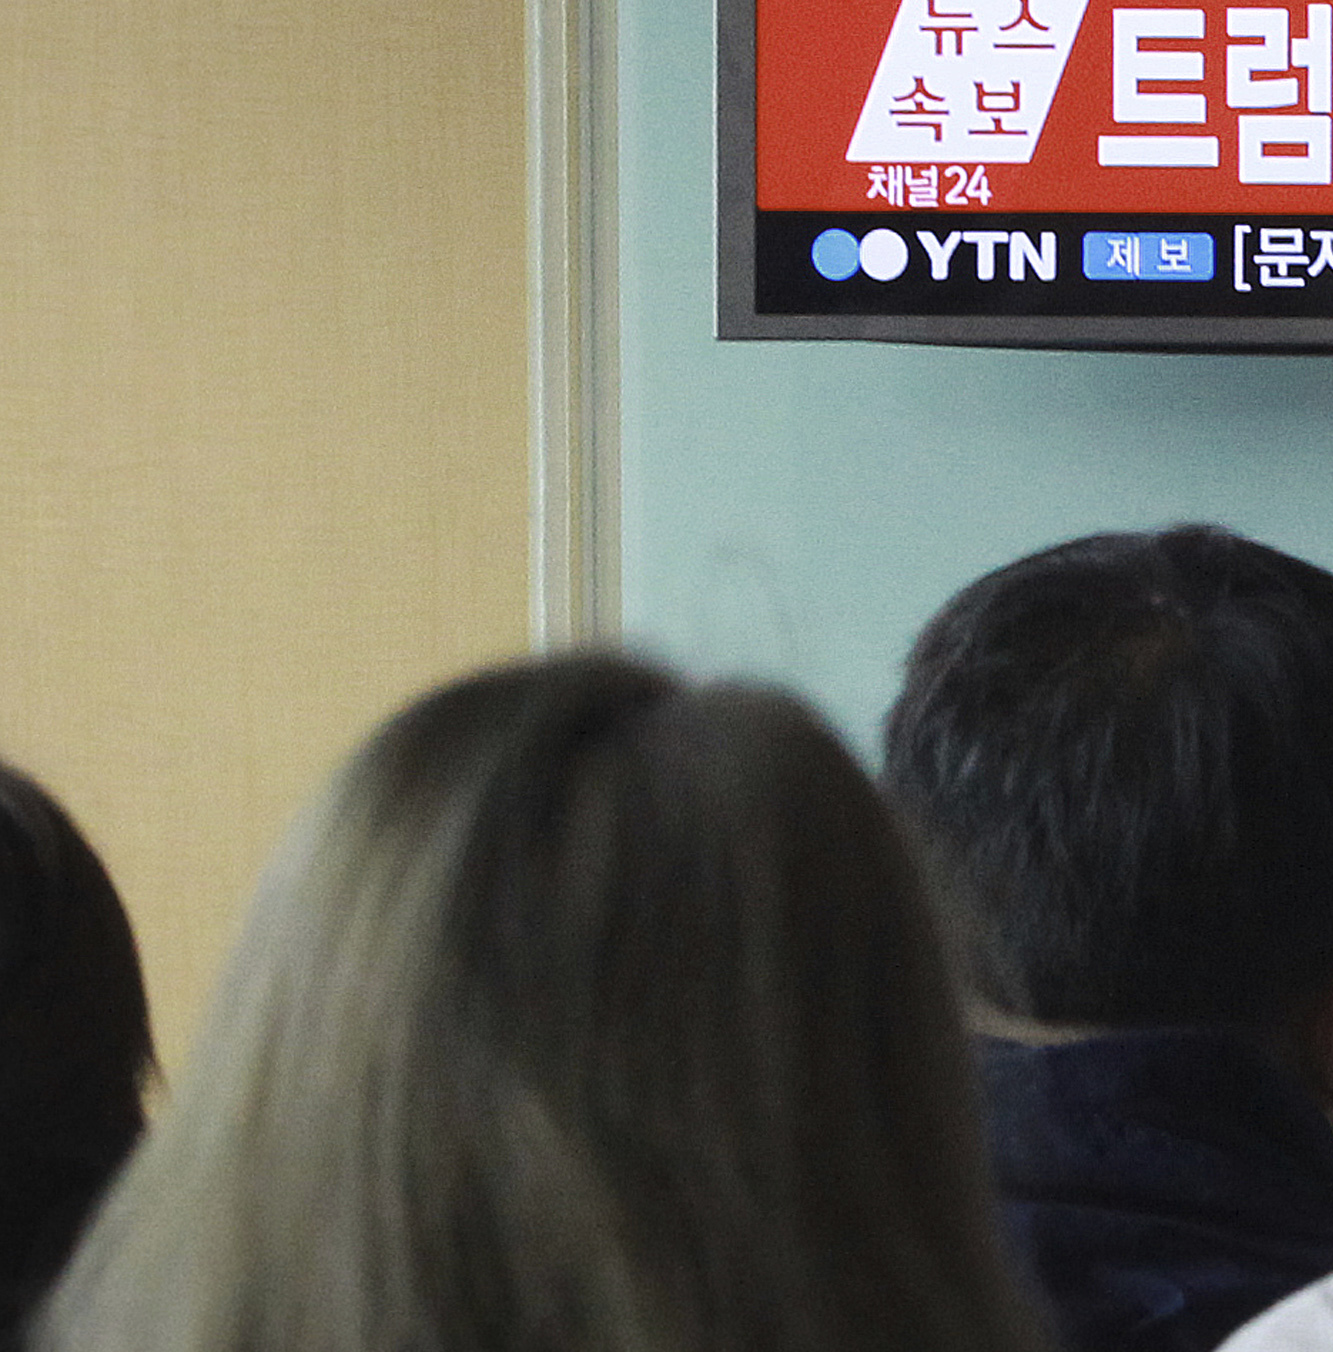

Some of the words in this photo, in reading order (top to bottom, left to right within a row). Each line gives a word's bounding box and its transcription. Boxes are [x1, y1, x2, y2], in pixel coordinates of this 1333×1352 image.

[888, 75, 1029, 142] 속보
[866, 164, 993, 208] 채널24
[915, 229, 1058, 282] YTN
